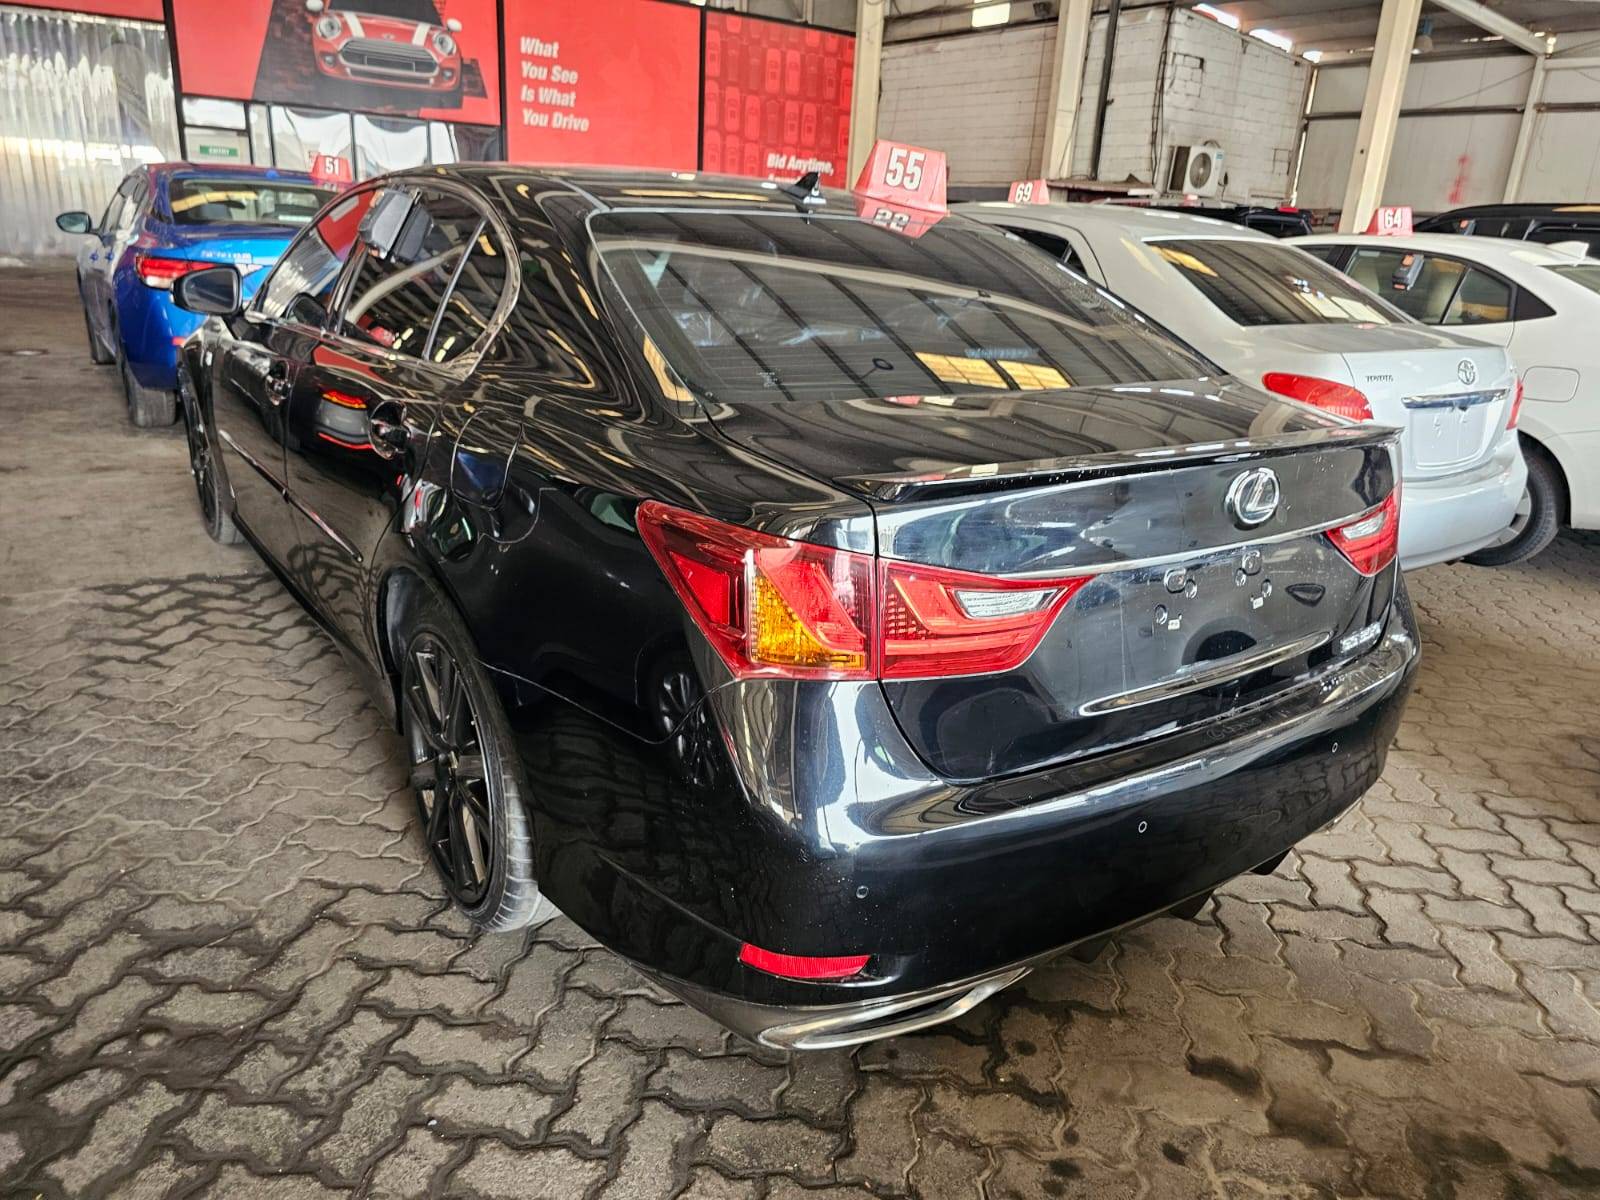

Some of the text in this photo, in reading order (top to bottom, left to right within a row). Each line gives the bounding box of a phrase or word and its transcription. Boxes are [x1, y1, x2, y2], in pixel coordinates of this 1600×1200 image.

[520, 36, 559, 58] What
[521, 60, 578, 84] You See
[521, 84, 576, 107] Is What
[522, 108, 589, 132] You Drive
[325, 156, 339, 176] 51
[767, 152, 834, 176] Bid Anytime,
[885, 147, 925, 190] 55
[1015, 182, 1033, 203] 69
[1384, 208, 1402, 229] 64
